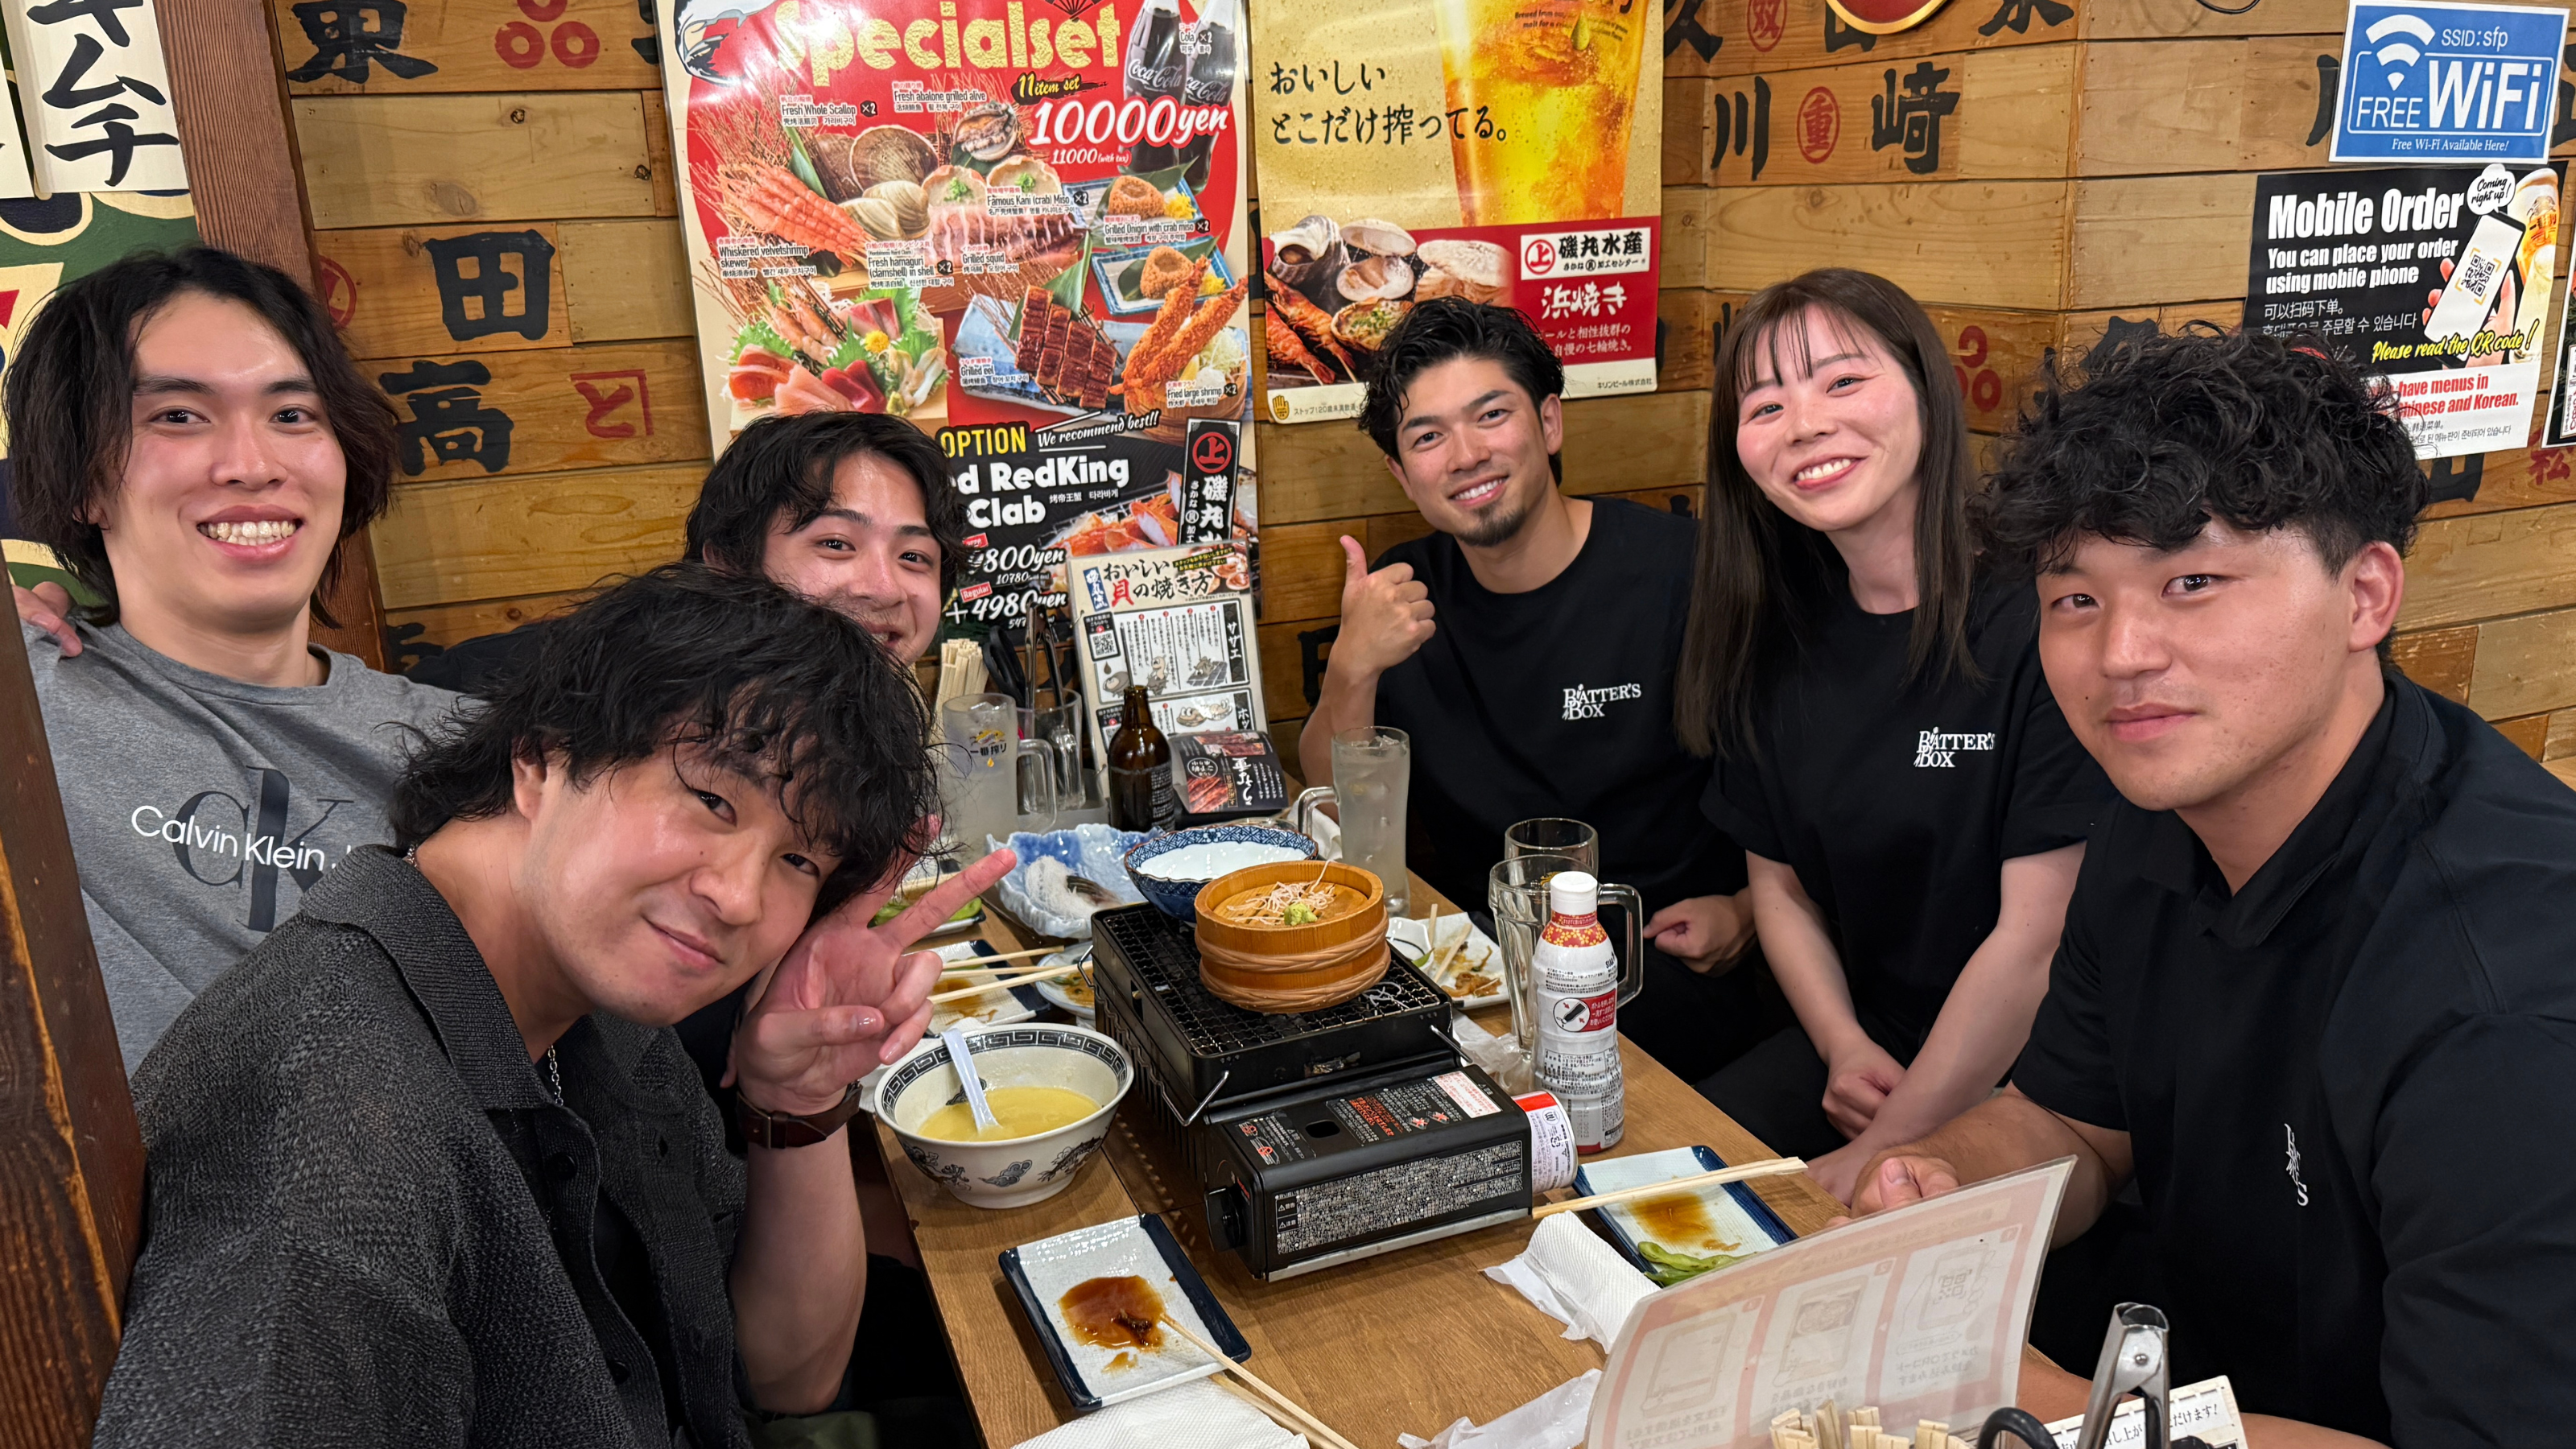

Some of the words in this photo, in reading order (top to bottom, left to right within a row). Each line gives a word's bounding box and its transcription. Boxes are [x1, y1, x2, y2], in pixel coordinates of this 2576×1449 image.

[774, 0, 1121, 87] Specialset
[1181, 32, 1195, 43] Cola
[1270, 60, 1386, 97] おいしい
[894, 90, 915, 101] Fresh
[917, 90, 944, 101] abalone
[946, 90, 968, 103] grilled
[970, 90, 986, 101] alive
[2355, 97, 2424, 128] FREE
[2428, 60, 2542, 130] WiFi
[782, 105, 803, 116] Fresh
[804, 105, 828, 116] Whole
[829, 104, 856, 117] Scallop
[1271, 103, 1507, 147] とこだけ搾ってる。
[2392, 138, 2413, 151] Free
[2415, 138, 2441, 151] Wi-Fi
[2442, 138, 2483, 152] Available
[2484, 139, 2510, 152] Here!
[2477, 177, 2508, 191] Coming
[987, 196, 1014, 206] Famous
[1016, 195, 1031, 205] Kani
[1033, 194, 1052, 204] (crab)
[1054, 194, 1070, 204] Miso
[2471, 190, 2495, 208] right
[2268, 192, 2375, 240] Mobile
[2380, 187, 2465, 233] Order
[1104, 225, 1125, 235] Grilled
[1149, 222, 1162, 232] with
[1164, 221, 1178, 231] crab
[1179, 221, 1194, 230] miso
[719, 246, 759, 257] Whiskered
[761, 245, 809, 257] velvetshrimp
[1558, 231, 1643, 259] 磯丸水産
[2267, 247, 2297, 270] You
[2299, 249, 2329, 267] can
[2332, 242, 2377, 266] place
[2380, 243, 2415, 266] your
[2417, 237, 2459, 259] order
[720, 259, 749, 268] skewer
[869, 257, 888, 267] Fresh
[890, 256, 923, 268] hamaguri
[962, 252, 984, 264] Grilled
[986, 252, 1005, 265] squid
[869, 266, 907, 279] (clamshell)
[909, 266, 916, 276] in
[918, 266, 935, 276] shell
[2265, 272, 2312, 295] using
[2313, 267, 2367, 291] mobile
[2369, 265, 2420, 289] phone
[423, 229, 556, 341] 田
[1541, 281, 1628, 320] 浜焼き
[2264, 298, 2343, 321] 可以扫码下单。
[1542, 322, 1632, 340] ールと相性抜群の
[2322, 317, 2355, 336] 주문할
[2357, 316, 2370, 333] 수
[2373, 312, 2417, 332] 있습니다
[2372, 339, 2413, 364] Please
[2414, 335, 2446, 357] read
[2446, 333, 2468, 357] the
[2470, 331, 2492, 356] QR
[960, 365, 982, 377] Grilled
[984, 365, 994, 375] eel
[1167, 389, 1183, 398] Fried
[1184, 388, 1199, 399] large
[1201, 386, 1222, 398] shrimp
[1597, 378, 1653, 389] キリンビール株式会社
[2398, 379, 2429, 398] have
[2430, 376, 2475, 394] menus
[2477, 373, 2489, 390] in
[2447, 394, 2474, 413] and
[2473, 391, 2519, 411] Korean.
[379, 360, 515, 477] 高
[940, 427, 1026, 458] OPTION
[1038, 432, 1056, 448] We
[1058, 418, 1125, 443] recommend
[991, 455, 1129, 488] RedKing
[966, 495, 1046, 529] Clab
[1104, 559, 1170, 581] おいしい
[962, 588, 990, 599] Regular
[1112, 571, 1213, 607] 貝の焼き方
[1227, 621, 1242, 659] サザエ
[1563, 683, 1641, 709] BATTER'S
[1567, 700, 1606, 720] BOX
[1916, 731, 1996, 753] BATTER'S
[1917, 745, 1956, 768] BOX
[131, 805, 238, 857] Calvin
[245, 833, 325, 872] Klein
